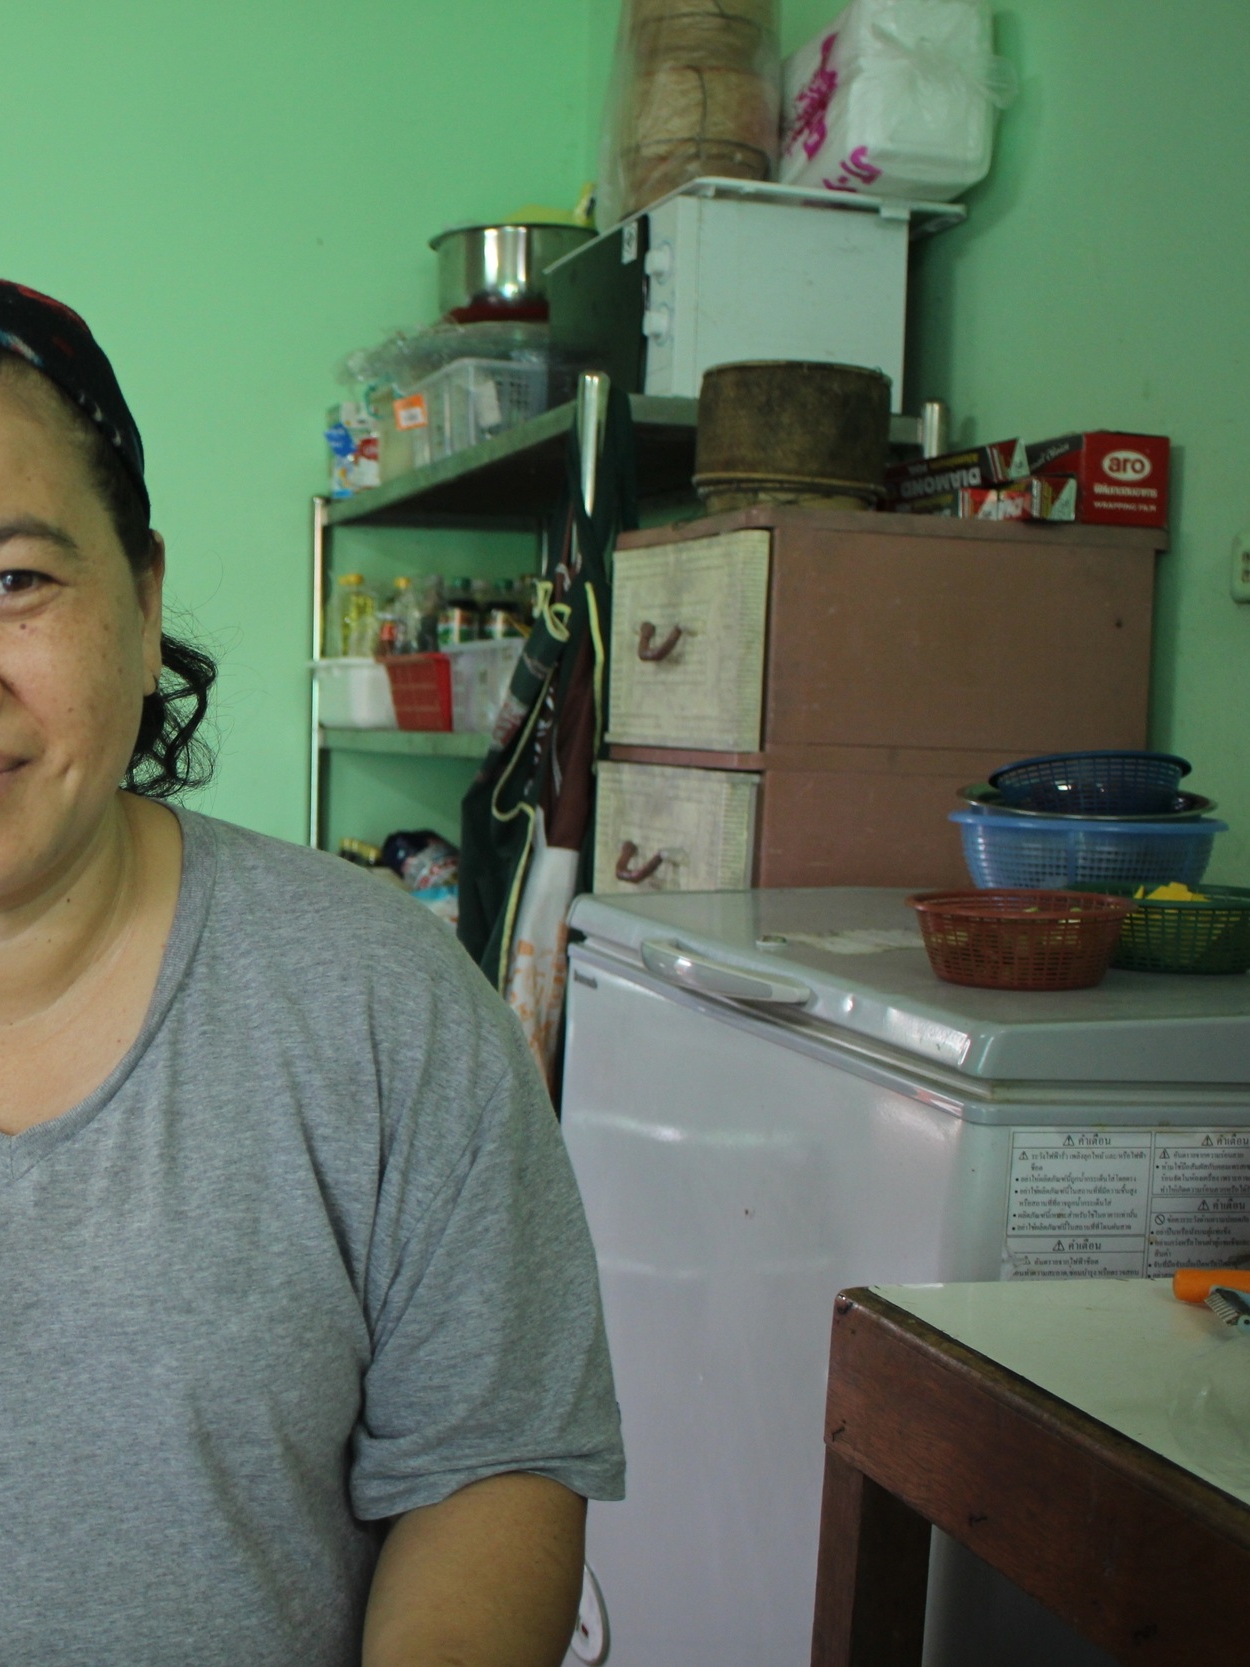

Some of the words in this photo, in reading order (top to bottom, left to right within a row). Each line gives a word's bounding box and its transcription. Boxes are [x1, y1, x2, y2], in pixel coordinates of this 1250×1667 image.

[1108, 457, 1145, 474] aro
[900, 466, 982, 498] DIAMOND
[1078, 1134, 1111, 1146] คำเตือน
[1216, 1134, 1249, 1146] คำเตือน
[1212, 1199, 1246, 1211] คำเตือน
[1068, 1238, 1102, 1250] คำเตือน
